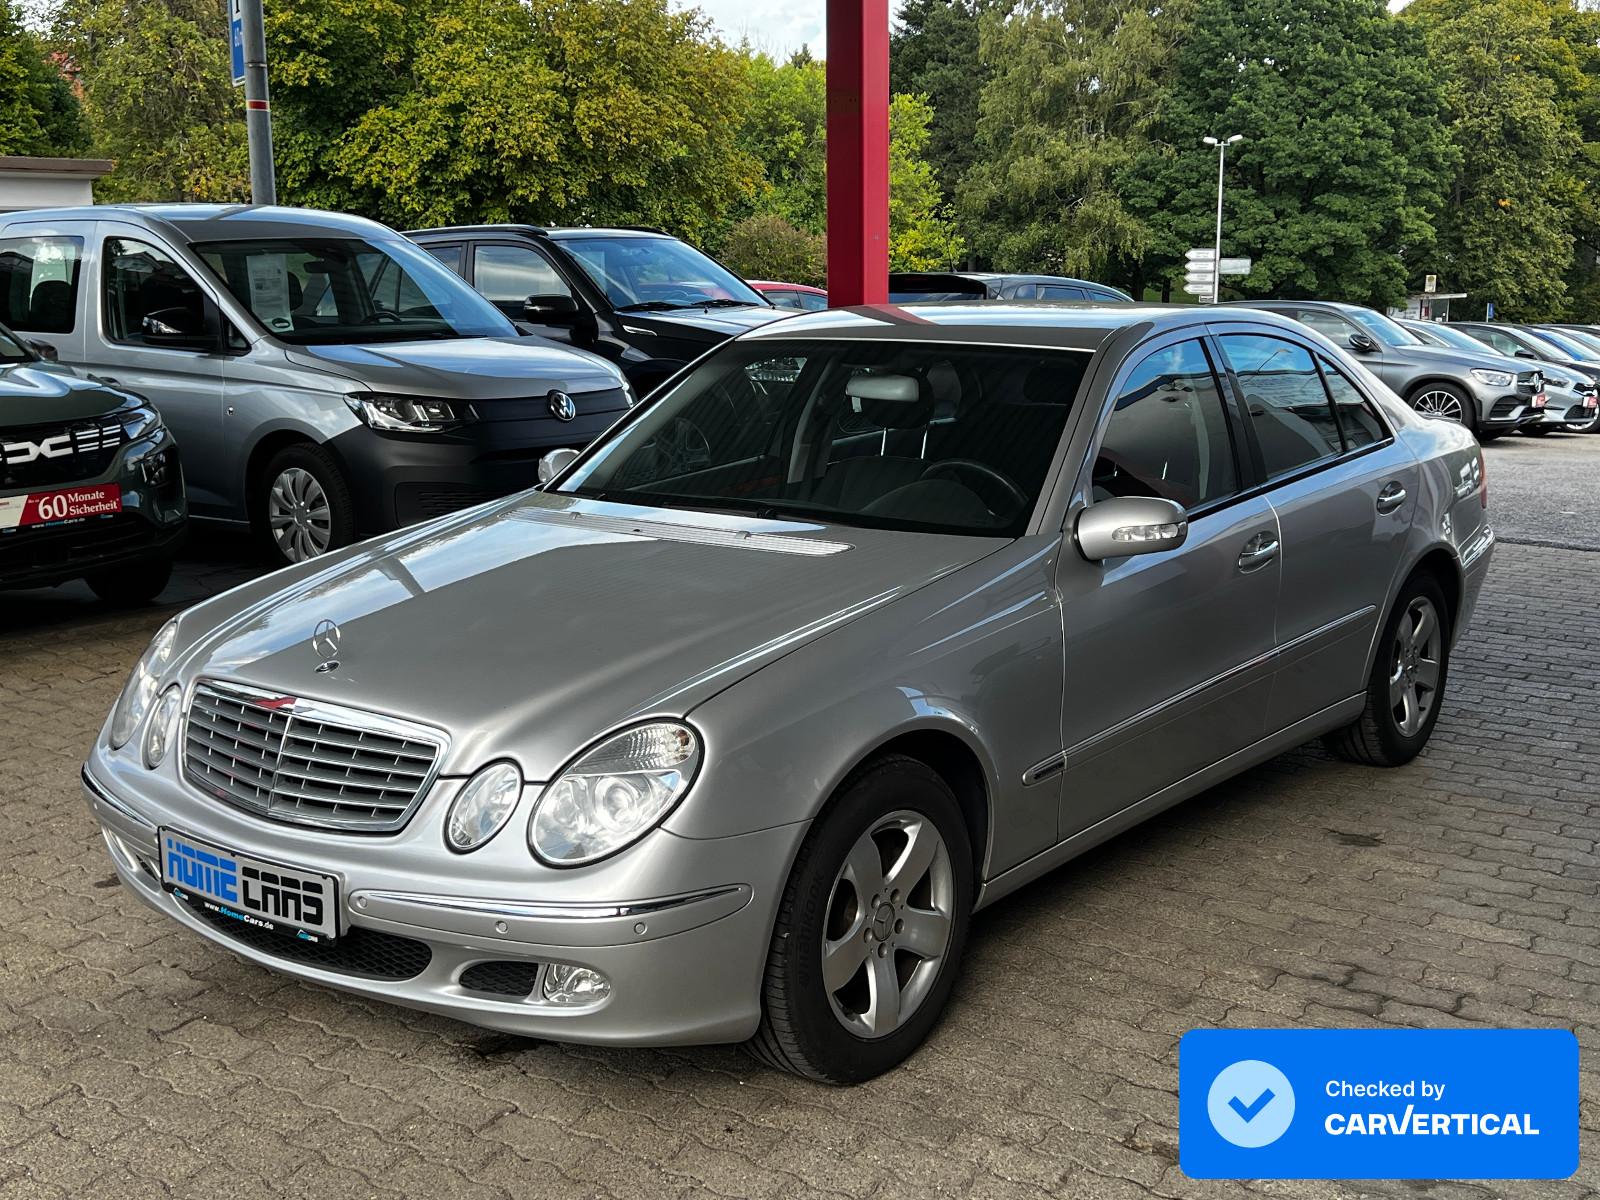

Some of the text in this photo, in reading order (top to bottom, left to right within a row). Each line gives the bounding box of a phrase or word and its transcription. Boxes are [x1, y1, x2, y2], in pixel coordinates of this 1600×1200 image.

[38, 495, 68, 519] 60
[67, 490, 105, 503] Monate
[204, 901, 275, 930] www.HomeCars.de
